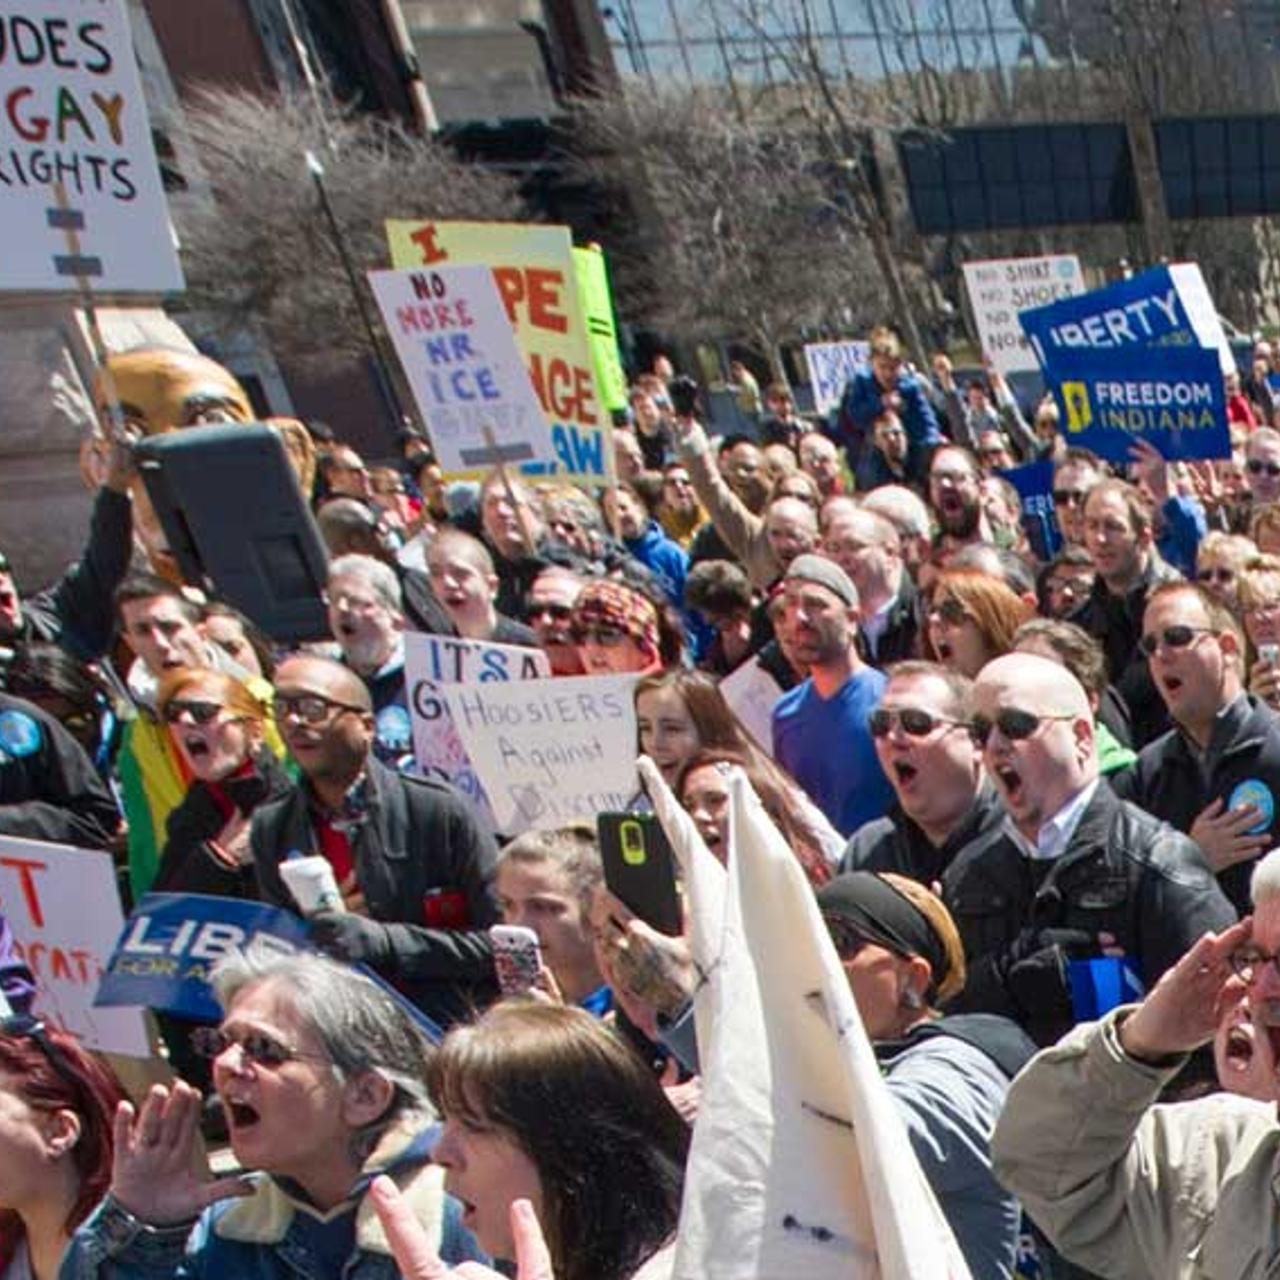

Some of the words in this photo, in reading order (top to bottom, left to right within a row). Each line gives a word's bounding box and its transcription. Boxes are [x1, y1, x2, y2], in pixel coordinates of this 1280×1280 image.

[0, 15, 111, 74] DES
[7, 86, 123, 145] GAY
[410, 225, 447, 264] I
[410, 273, 446, 300] NO
[492, 267, 567, 334] PE
[430, 368, 500, 404] ICE
[1096, 382, 1212, 405] FREEDOM
[1099, 404, 1215, 430] INDIANA
[430, 640, 509, 682] IT'S
